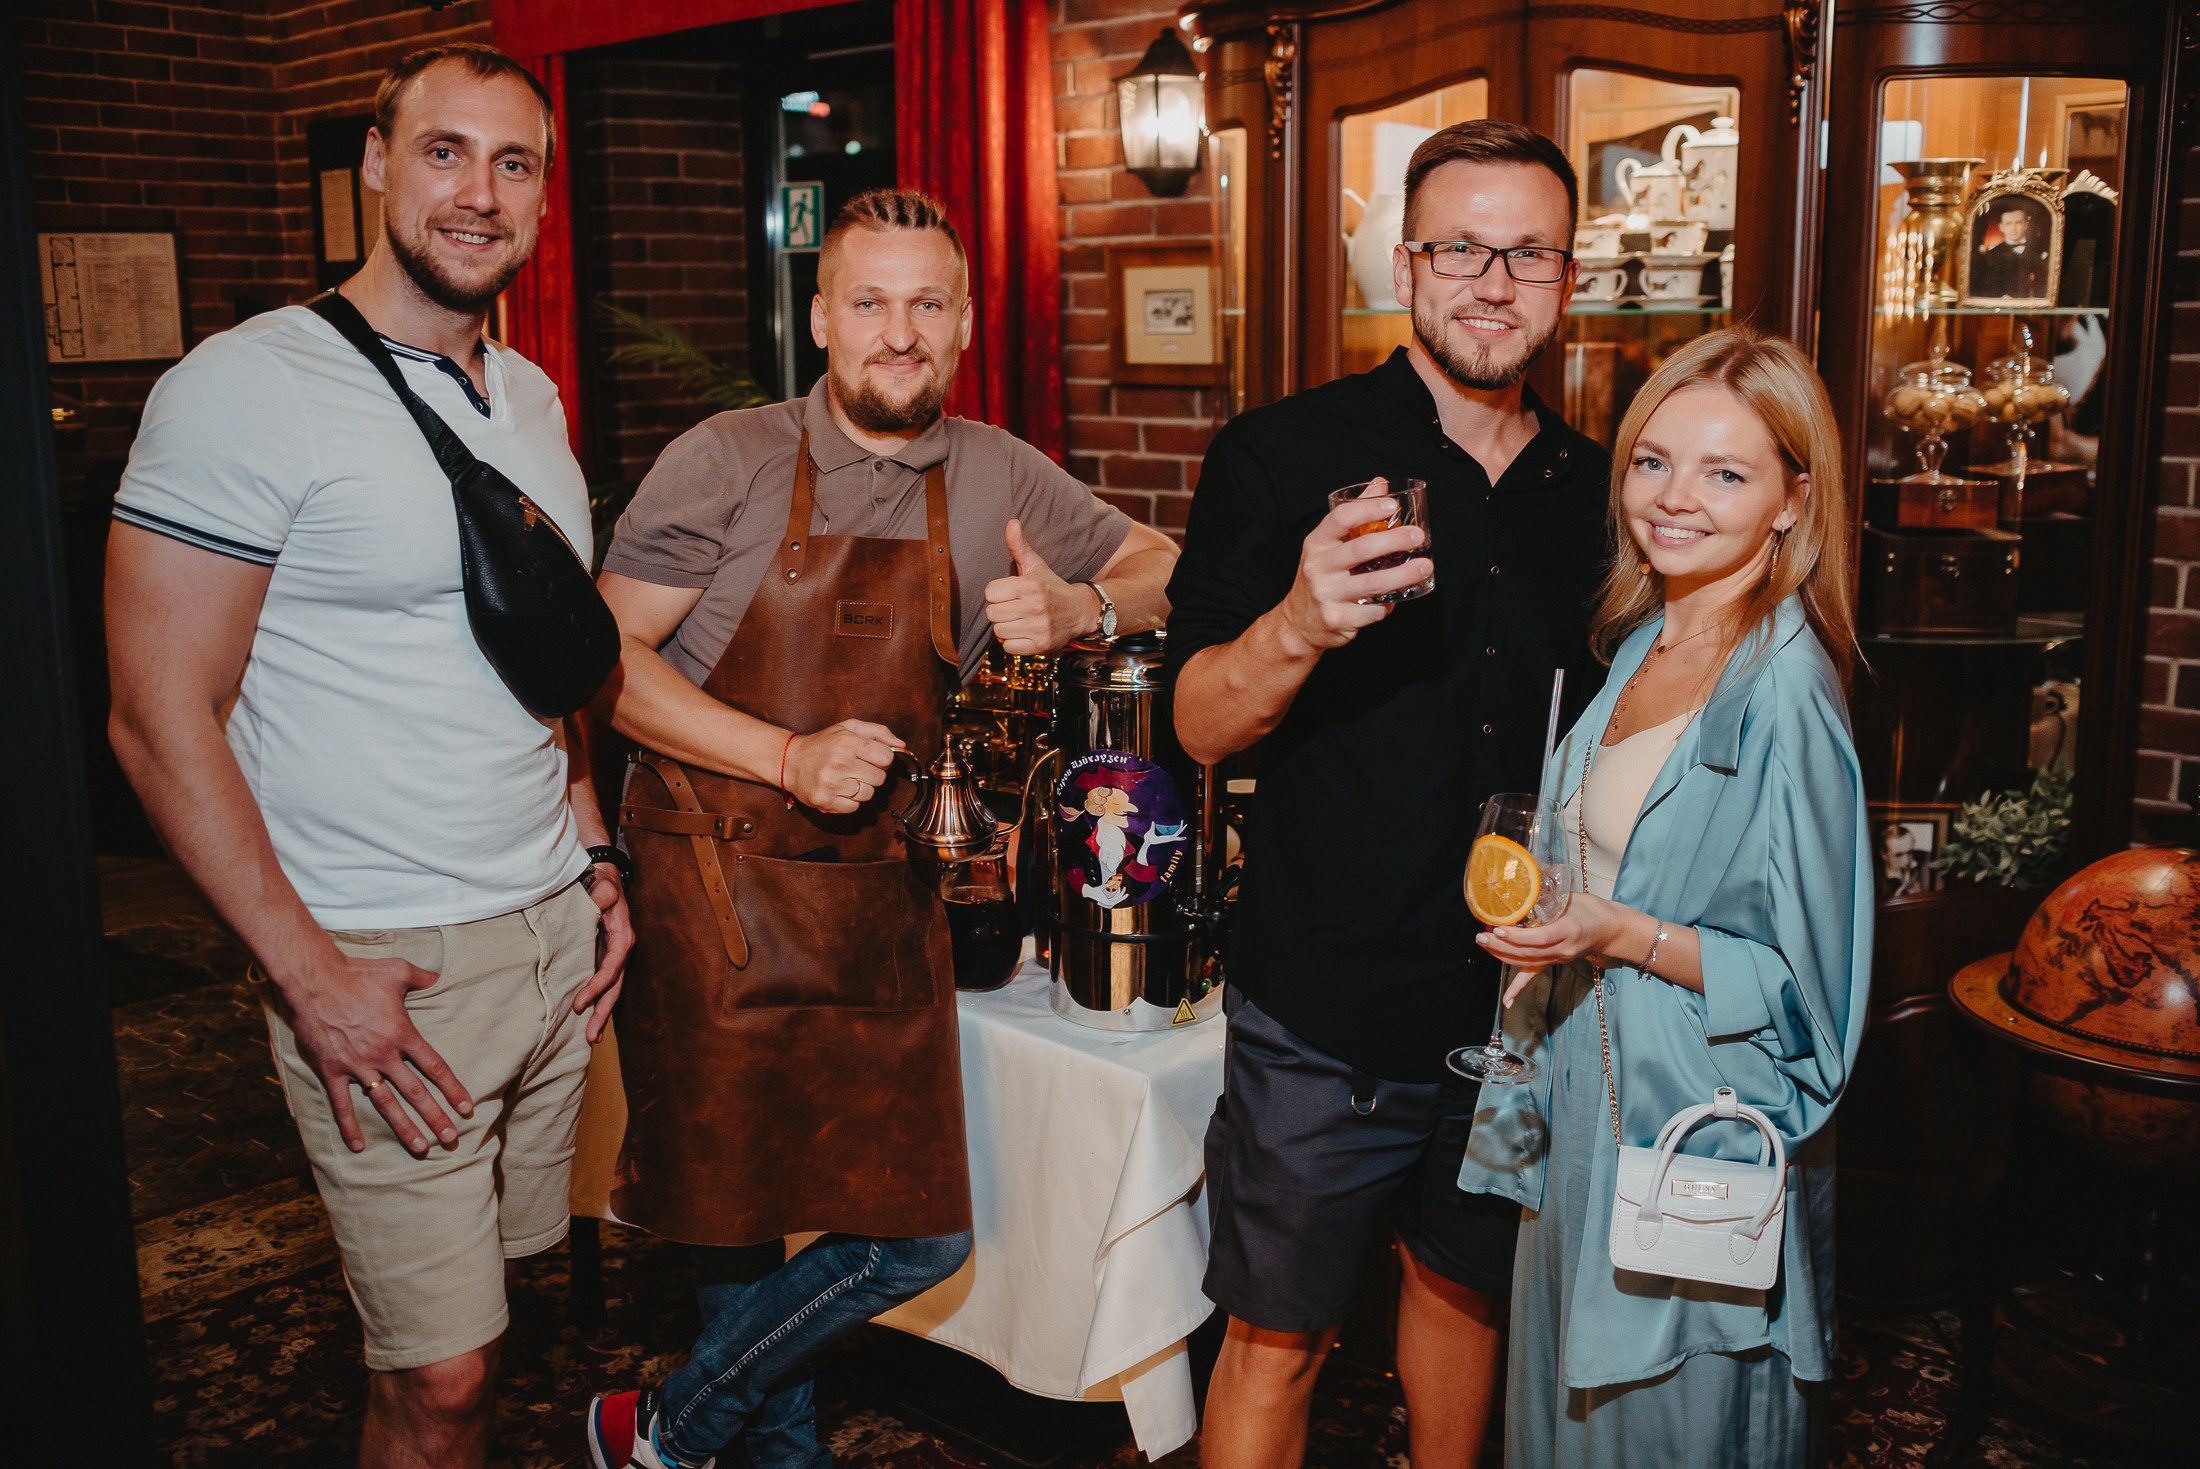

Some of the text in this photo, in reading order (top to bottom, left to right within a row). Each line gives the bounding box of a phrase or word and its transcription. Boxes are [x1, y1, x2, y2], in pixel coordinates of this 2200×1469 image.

[843, 613, 885, 626] BORK
[1160, 849, 1183, 883] family
[1683, 1184, 1716, 1194] GUESS
